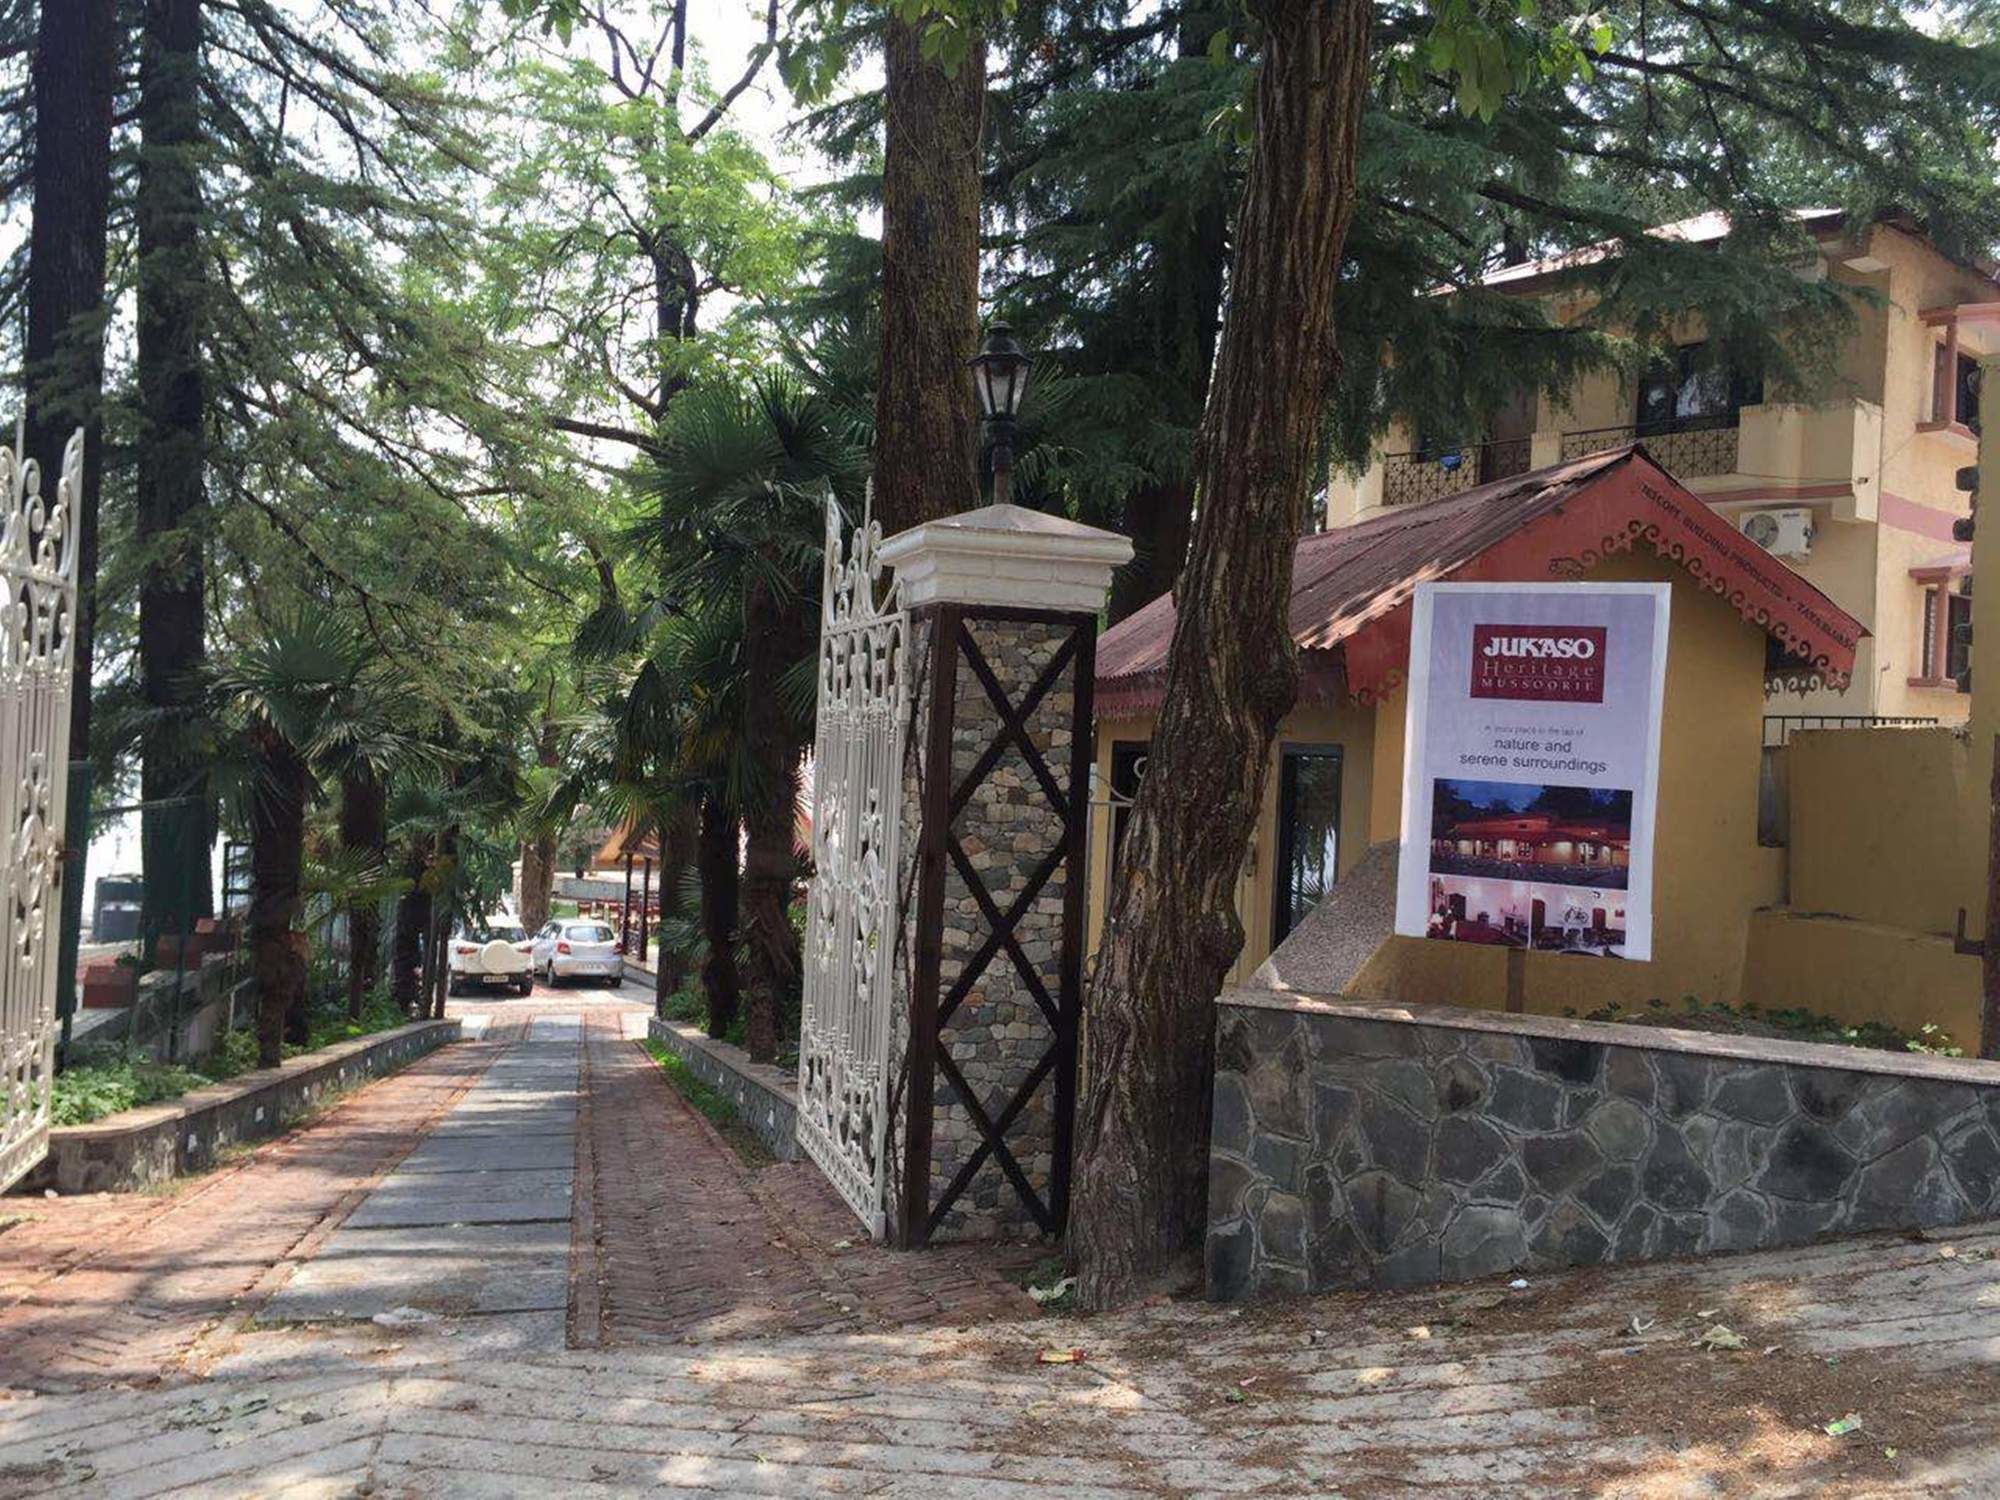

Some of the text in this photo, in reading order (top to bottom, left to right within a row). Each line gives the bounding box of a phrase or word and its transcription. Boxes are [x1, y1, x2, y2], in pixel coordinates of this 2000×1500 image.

[1482, 636, 1596, 659] JUKASO
[1483, 659, 1595, 680] Heritage
[1480, 677, 1594, 691] MUSSOORIE
[1494, 738, 1572, 753] nature and
[1459, 753, 1607, 775] serene surroundings
